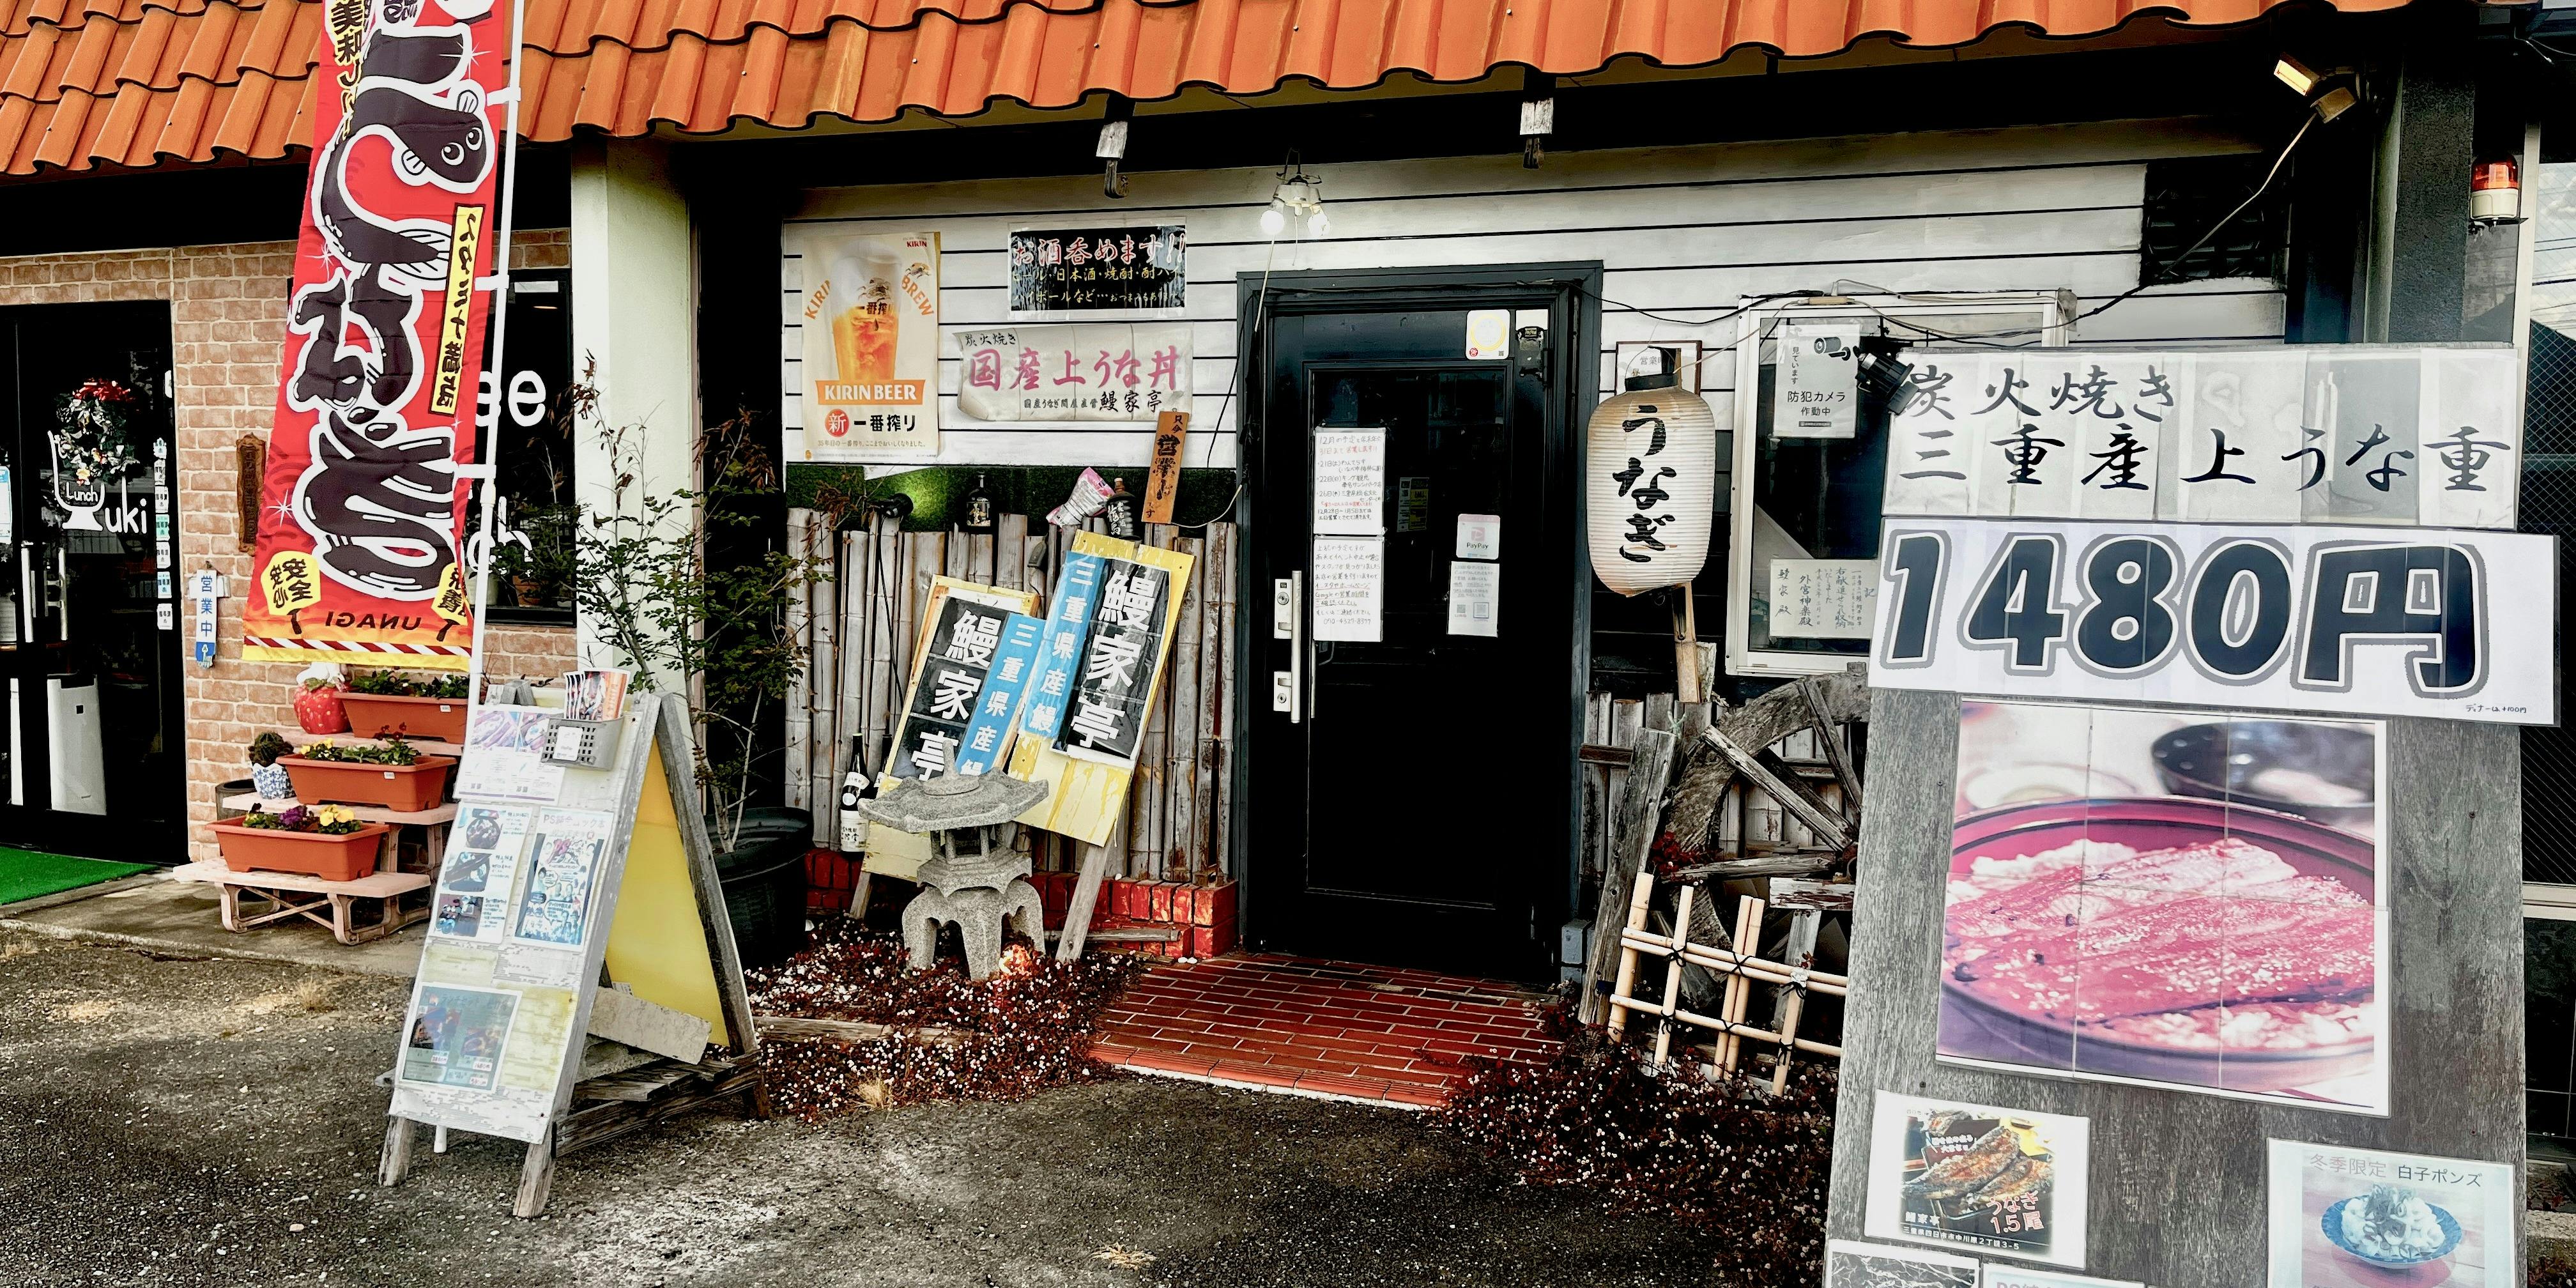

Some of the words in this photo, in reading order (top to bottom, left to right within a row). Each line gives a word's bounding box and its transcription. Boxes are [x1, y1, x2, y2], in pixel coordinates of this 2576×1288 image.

[901, 275, 935, 316] BREW
[965, 332, 1016, 347] 炭火焼き
[969, 345, 1181, 392] 国産上うな丼
[1639, 356, 1662, 365] 営業
[1791, 346, 1800, 385] 見ています
[824, 385, 871, 401] KIRIN
[873, 385, 917, 401] BEER
[1098, 390, 1163, 413] 鰻家亭
[1787, 390, 1846, 403] 防犯カメラ
[1901, 364, 2176, 422] 炭火焼き
[828, 413, 847, 434] 新
[854, 414, 916, 432] 一番搾り
[1800, 406, 1831, 417] 作動中
[1899, 422, 2512, 494] 三重産上うな重
[66, 482, 98, 502] Lunch
[1611, 404, 1677, 563] うなぎ
[200, 575, 213, 637] 営業中
[1880, 530, 2488, 696] 1480円
[1031, 560, 1098, 734] 三重県産鰻
[1070, 569, 1157, 751] 鰻家亭
[2309, 1153, 2387, 1178] 冬季限定
[2397, 1164, 2483, 1188] 白子ポンズ
[1986, 1190, 2039, 1216] うなぎ
[1990, 1210, 2044, 1235] 1.5尾
